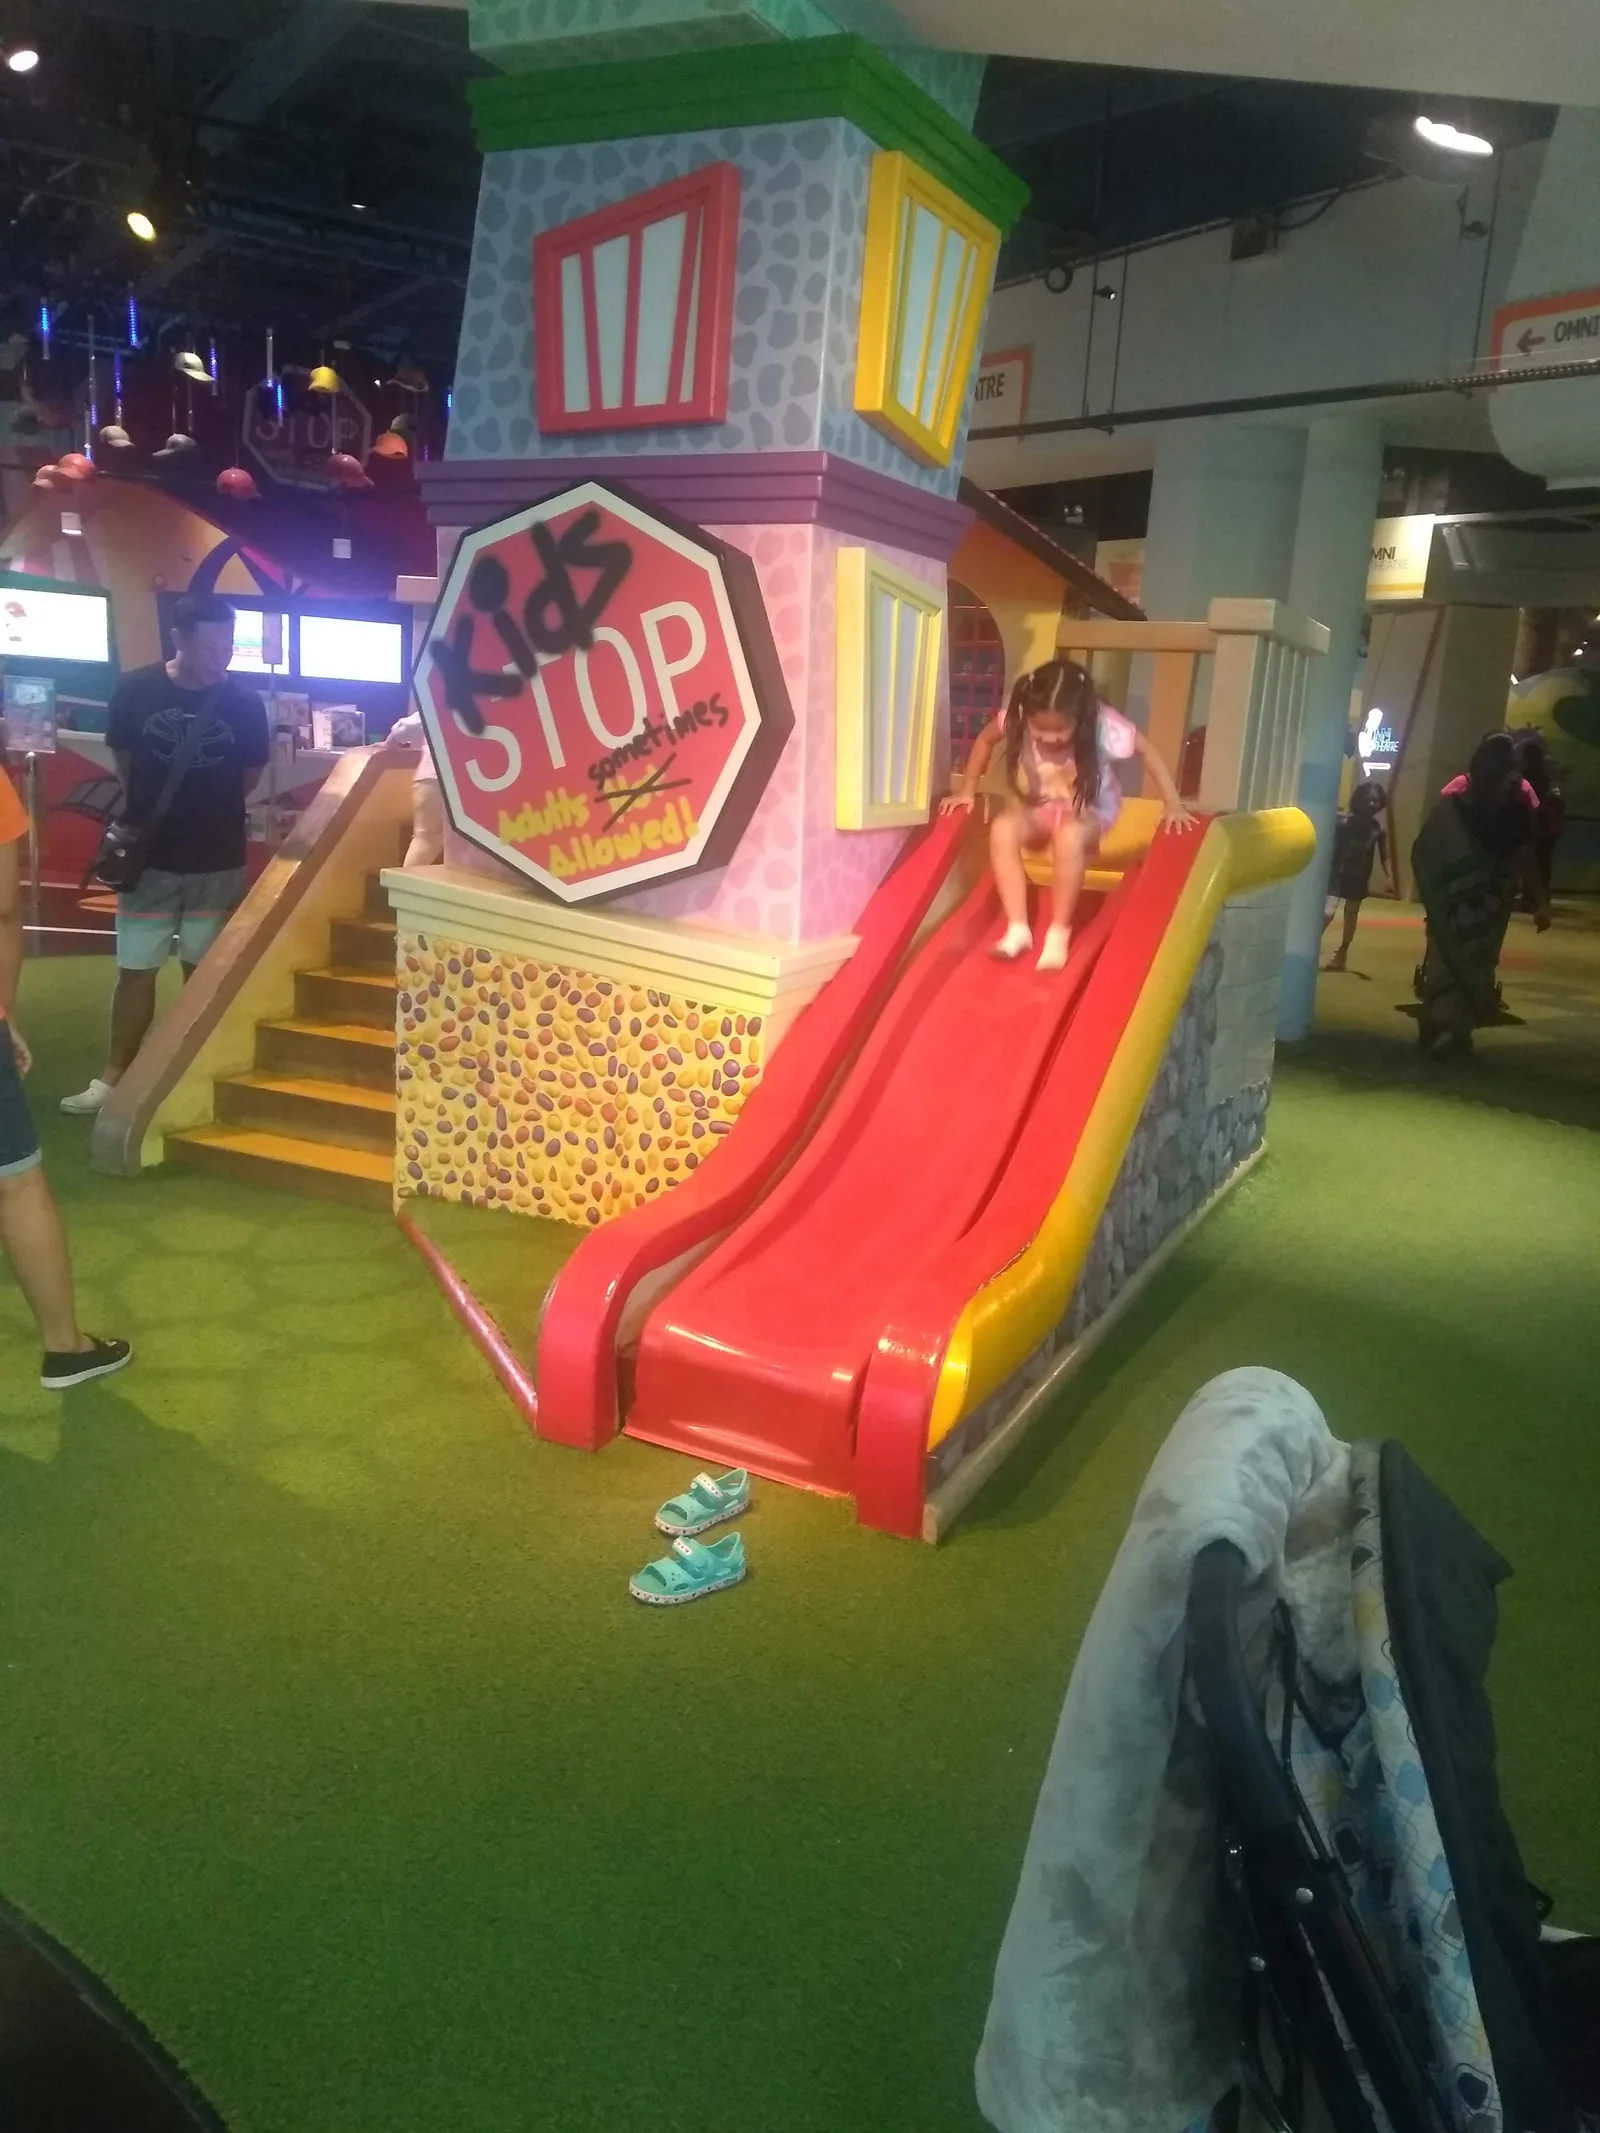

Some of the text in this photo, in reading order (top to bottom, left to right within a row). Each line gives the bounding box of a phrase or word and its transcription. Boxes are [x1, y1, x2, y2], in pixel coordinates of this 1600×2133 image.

[1554, 315, 1600, 343] OMNI
[430, 509, 632, 736] Kids
[452, 600, 708, 793] STOP
[587, 692, 730, 791] sometimes
[498, 786, 590, 845] Adults
[549, 796, 699, 878] Allowed!
